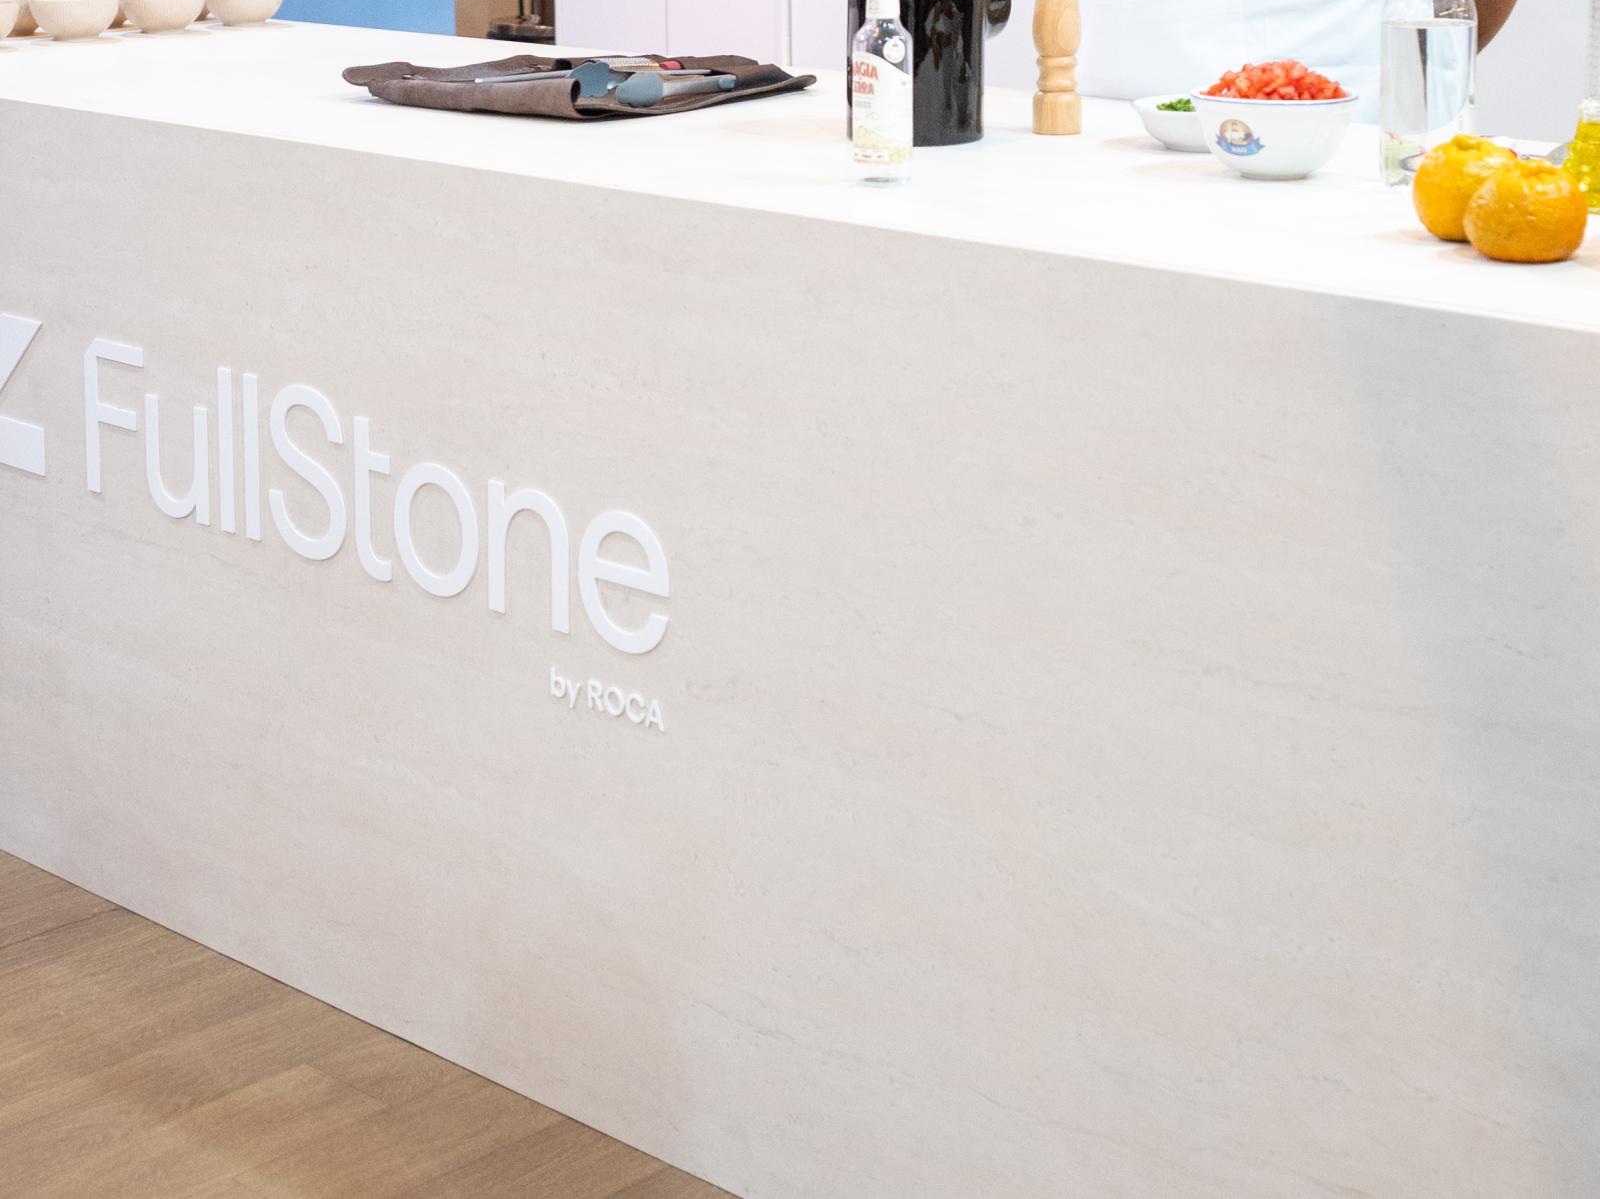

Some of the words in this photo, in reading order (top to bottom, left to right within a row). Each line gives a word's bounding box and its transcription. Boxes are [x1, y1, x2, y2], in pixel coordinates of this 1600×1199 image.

[84, 338, 670, 654] FullStone
[550, 666, 581, 709] by
[588, 679, 666, 732] ROCA
